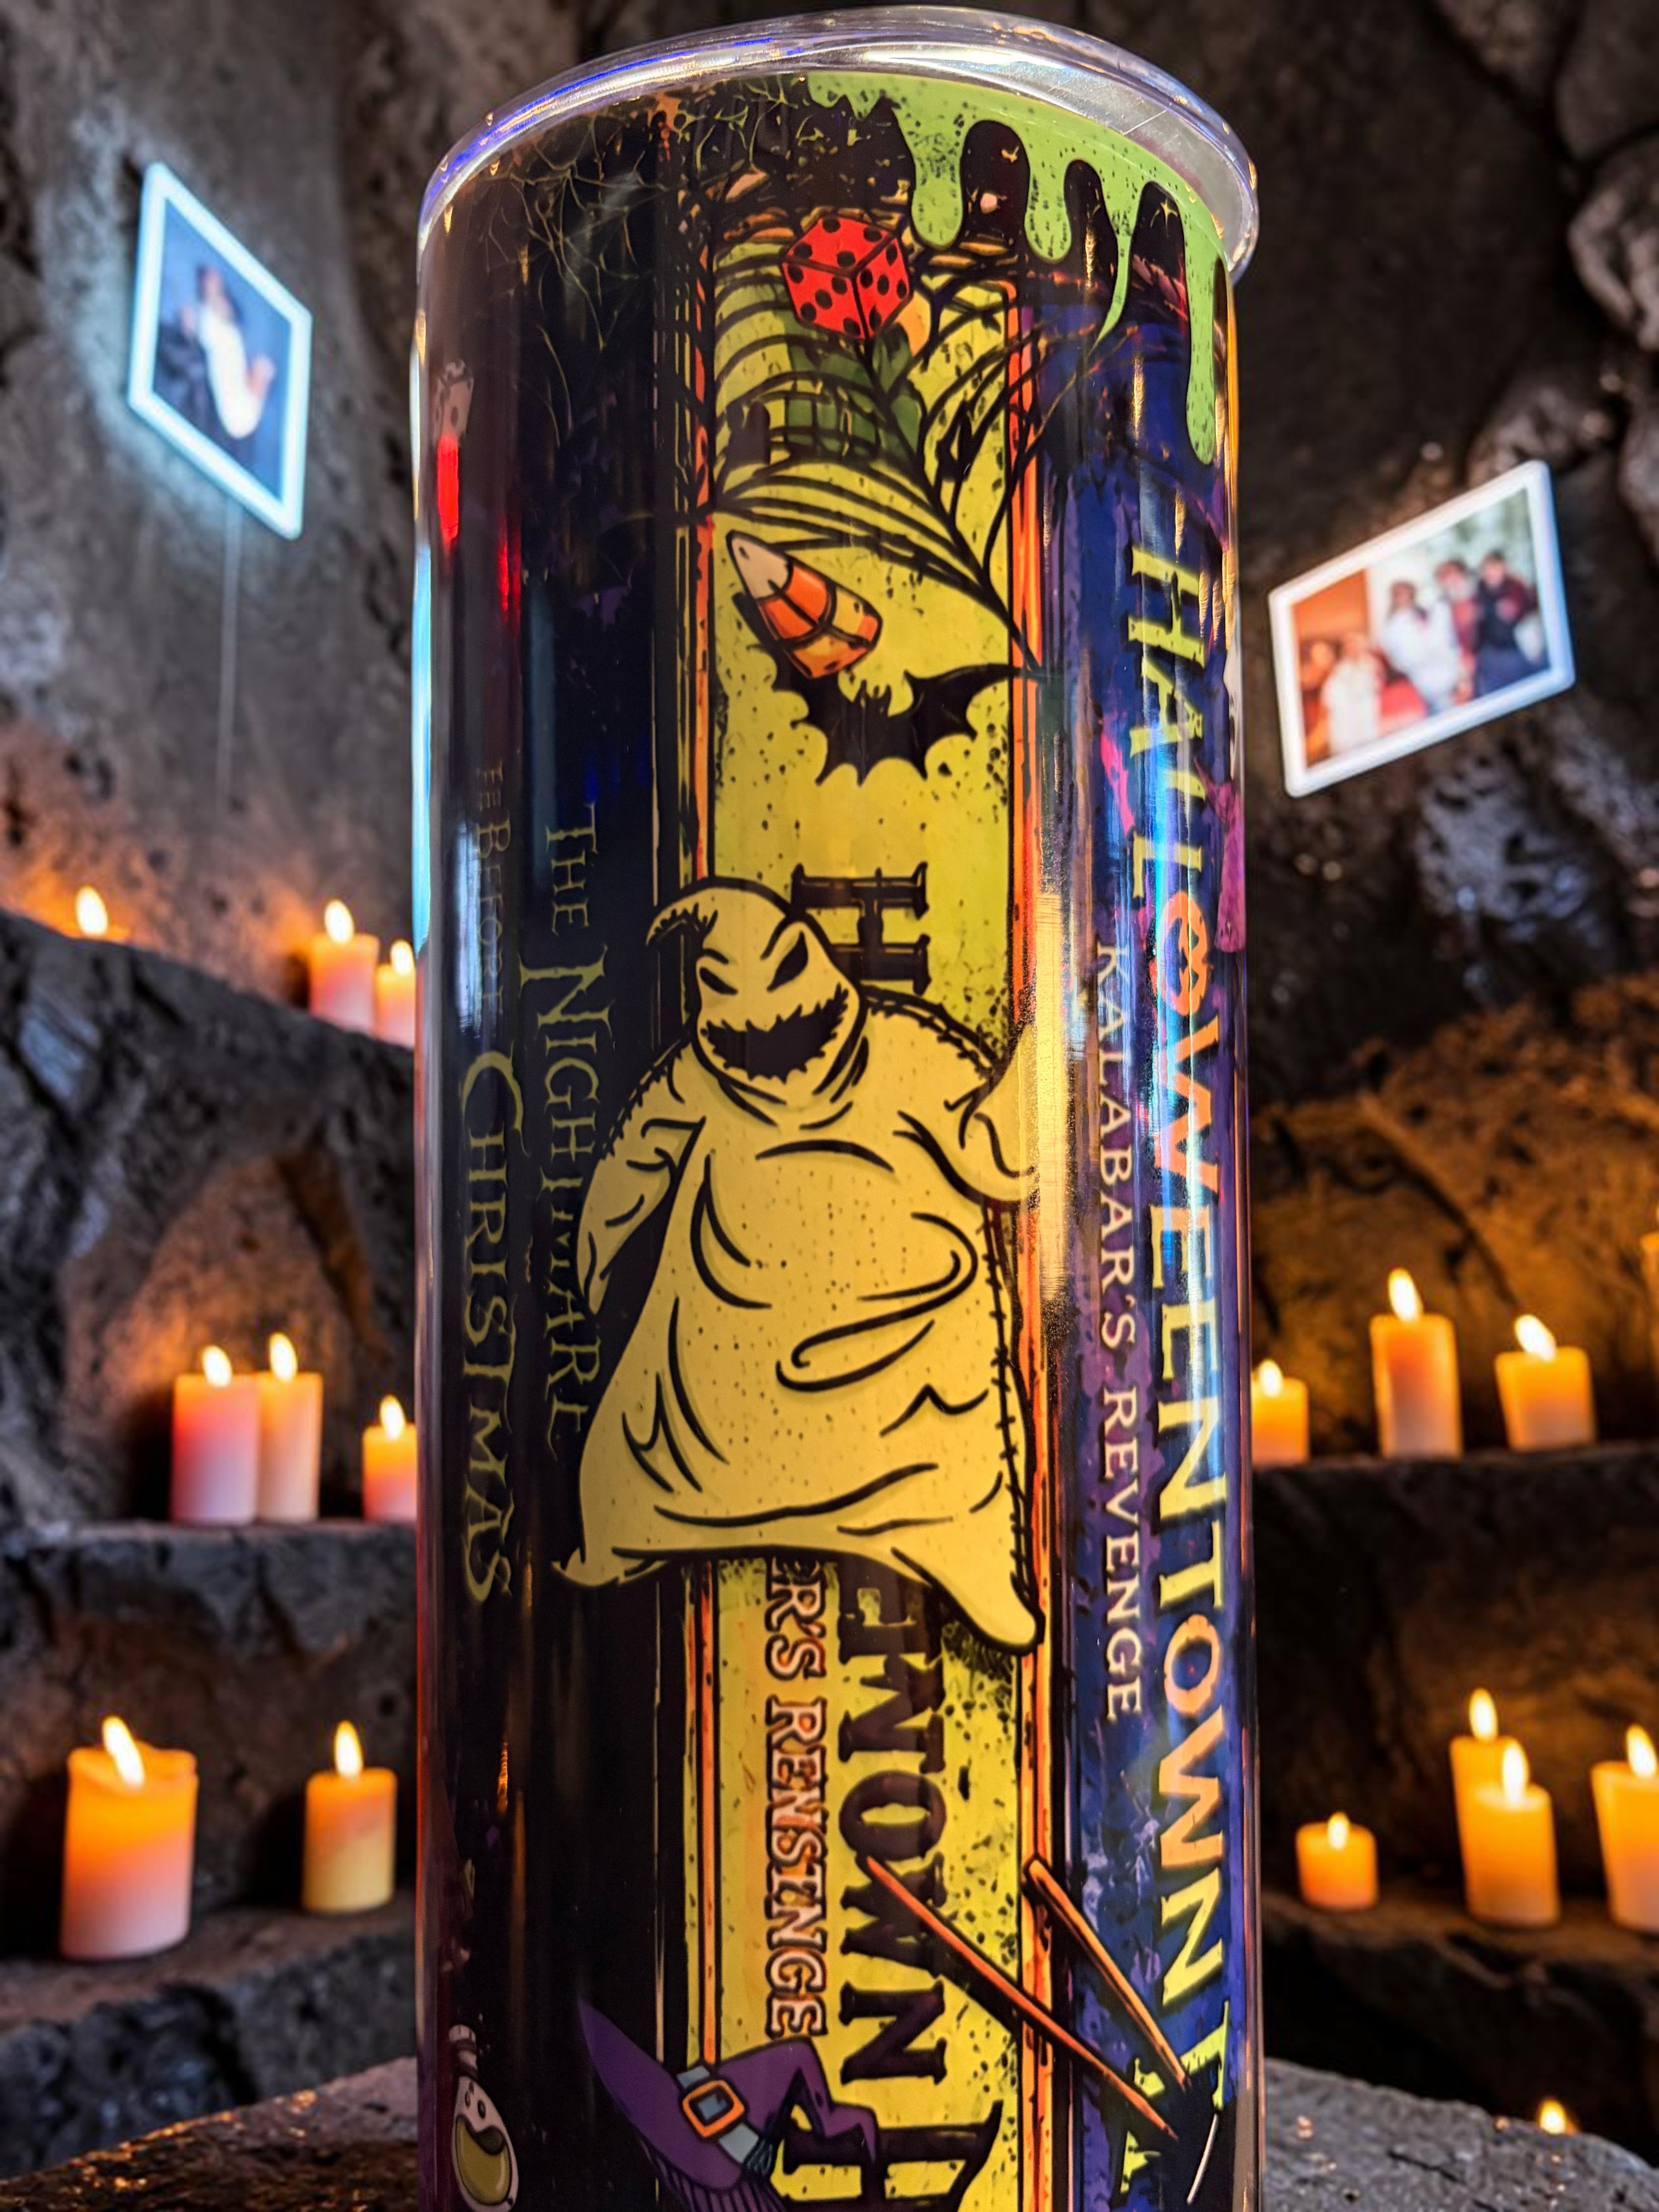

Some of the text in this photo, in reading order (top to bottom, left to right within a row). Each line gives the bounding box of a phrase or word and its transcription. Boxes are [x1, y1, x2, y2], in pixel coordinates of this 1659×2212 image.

[546, 801, 599, 935] THE
[460, 1040, 531, 1604] CHRISTMAS
[1096, 941, 1143, 1723] KALABAR'S REVENGE
